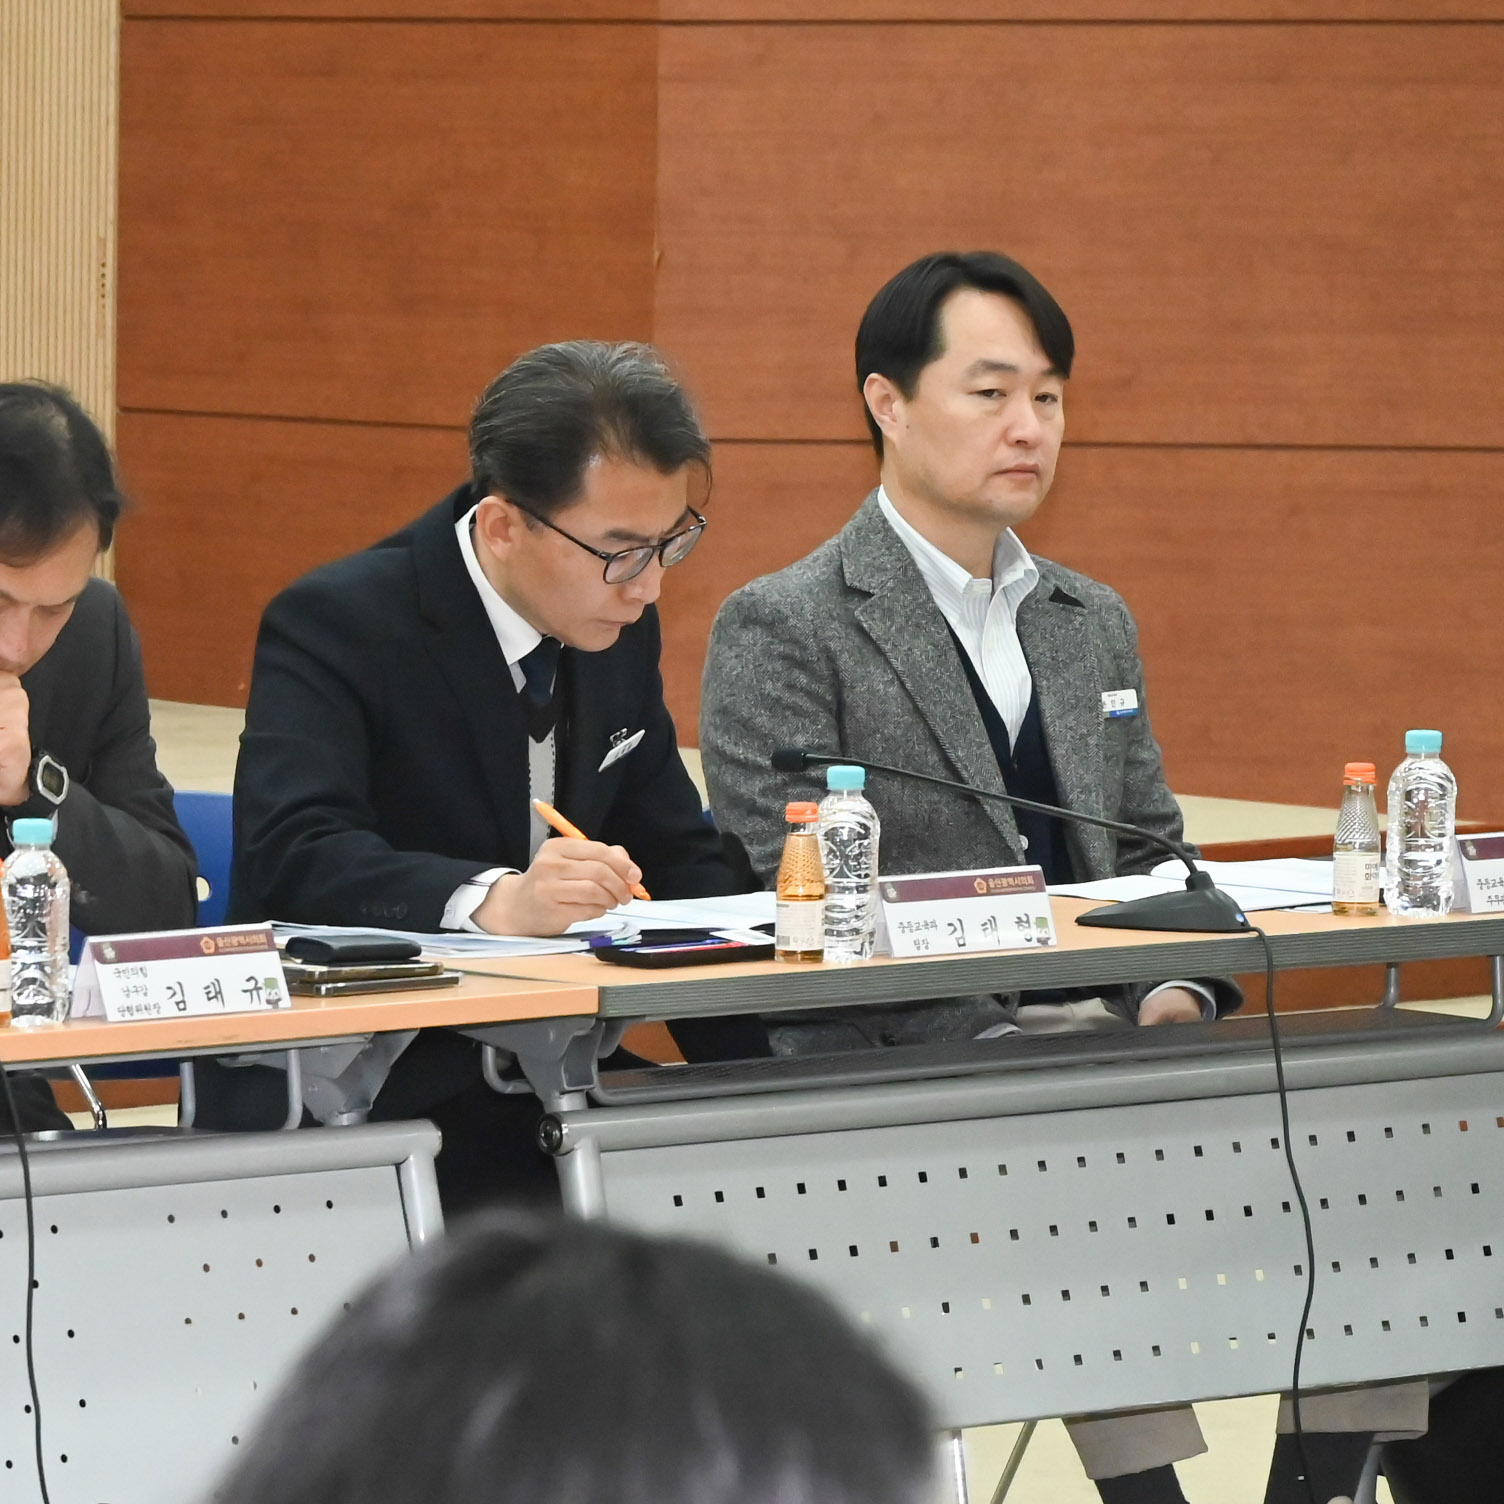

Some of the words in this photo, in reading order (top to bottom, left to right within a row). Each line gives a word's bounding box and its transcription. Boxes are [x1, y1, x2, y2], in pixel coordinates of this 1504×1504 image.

[897, 920, 938, 934] 중등교육과
[913, 937, 931, 951] 팀장
[113, 966, 148, 979] 국민의힘
